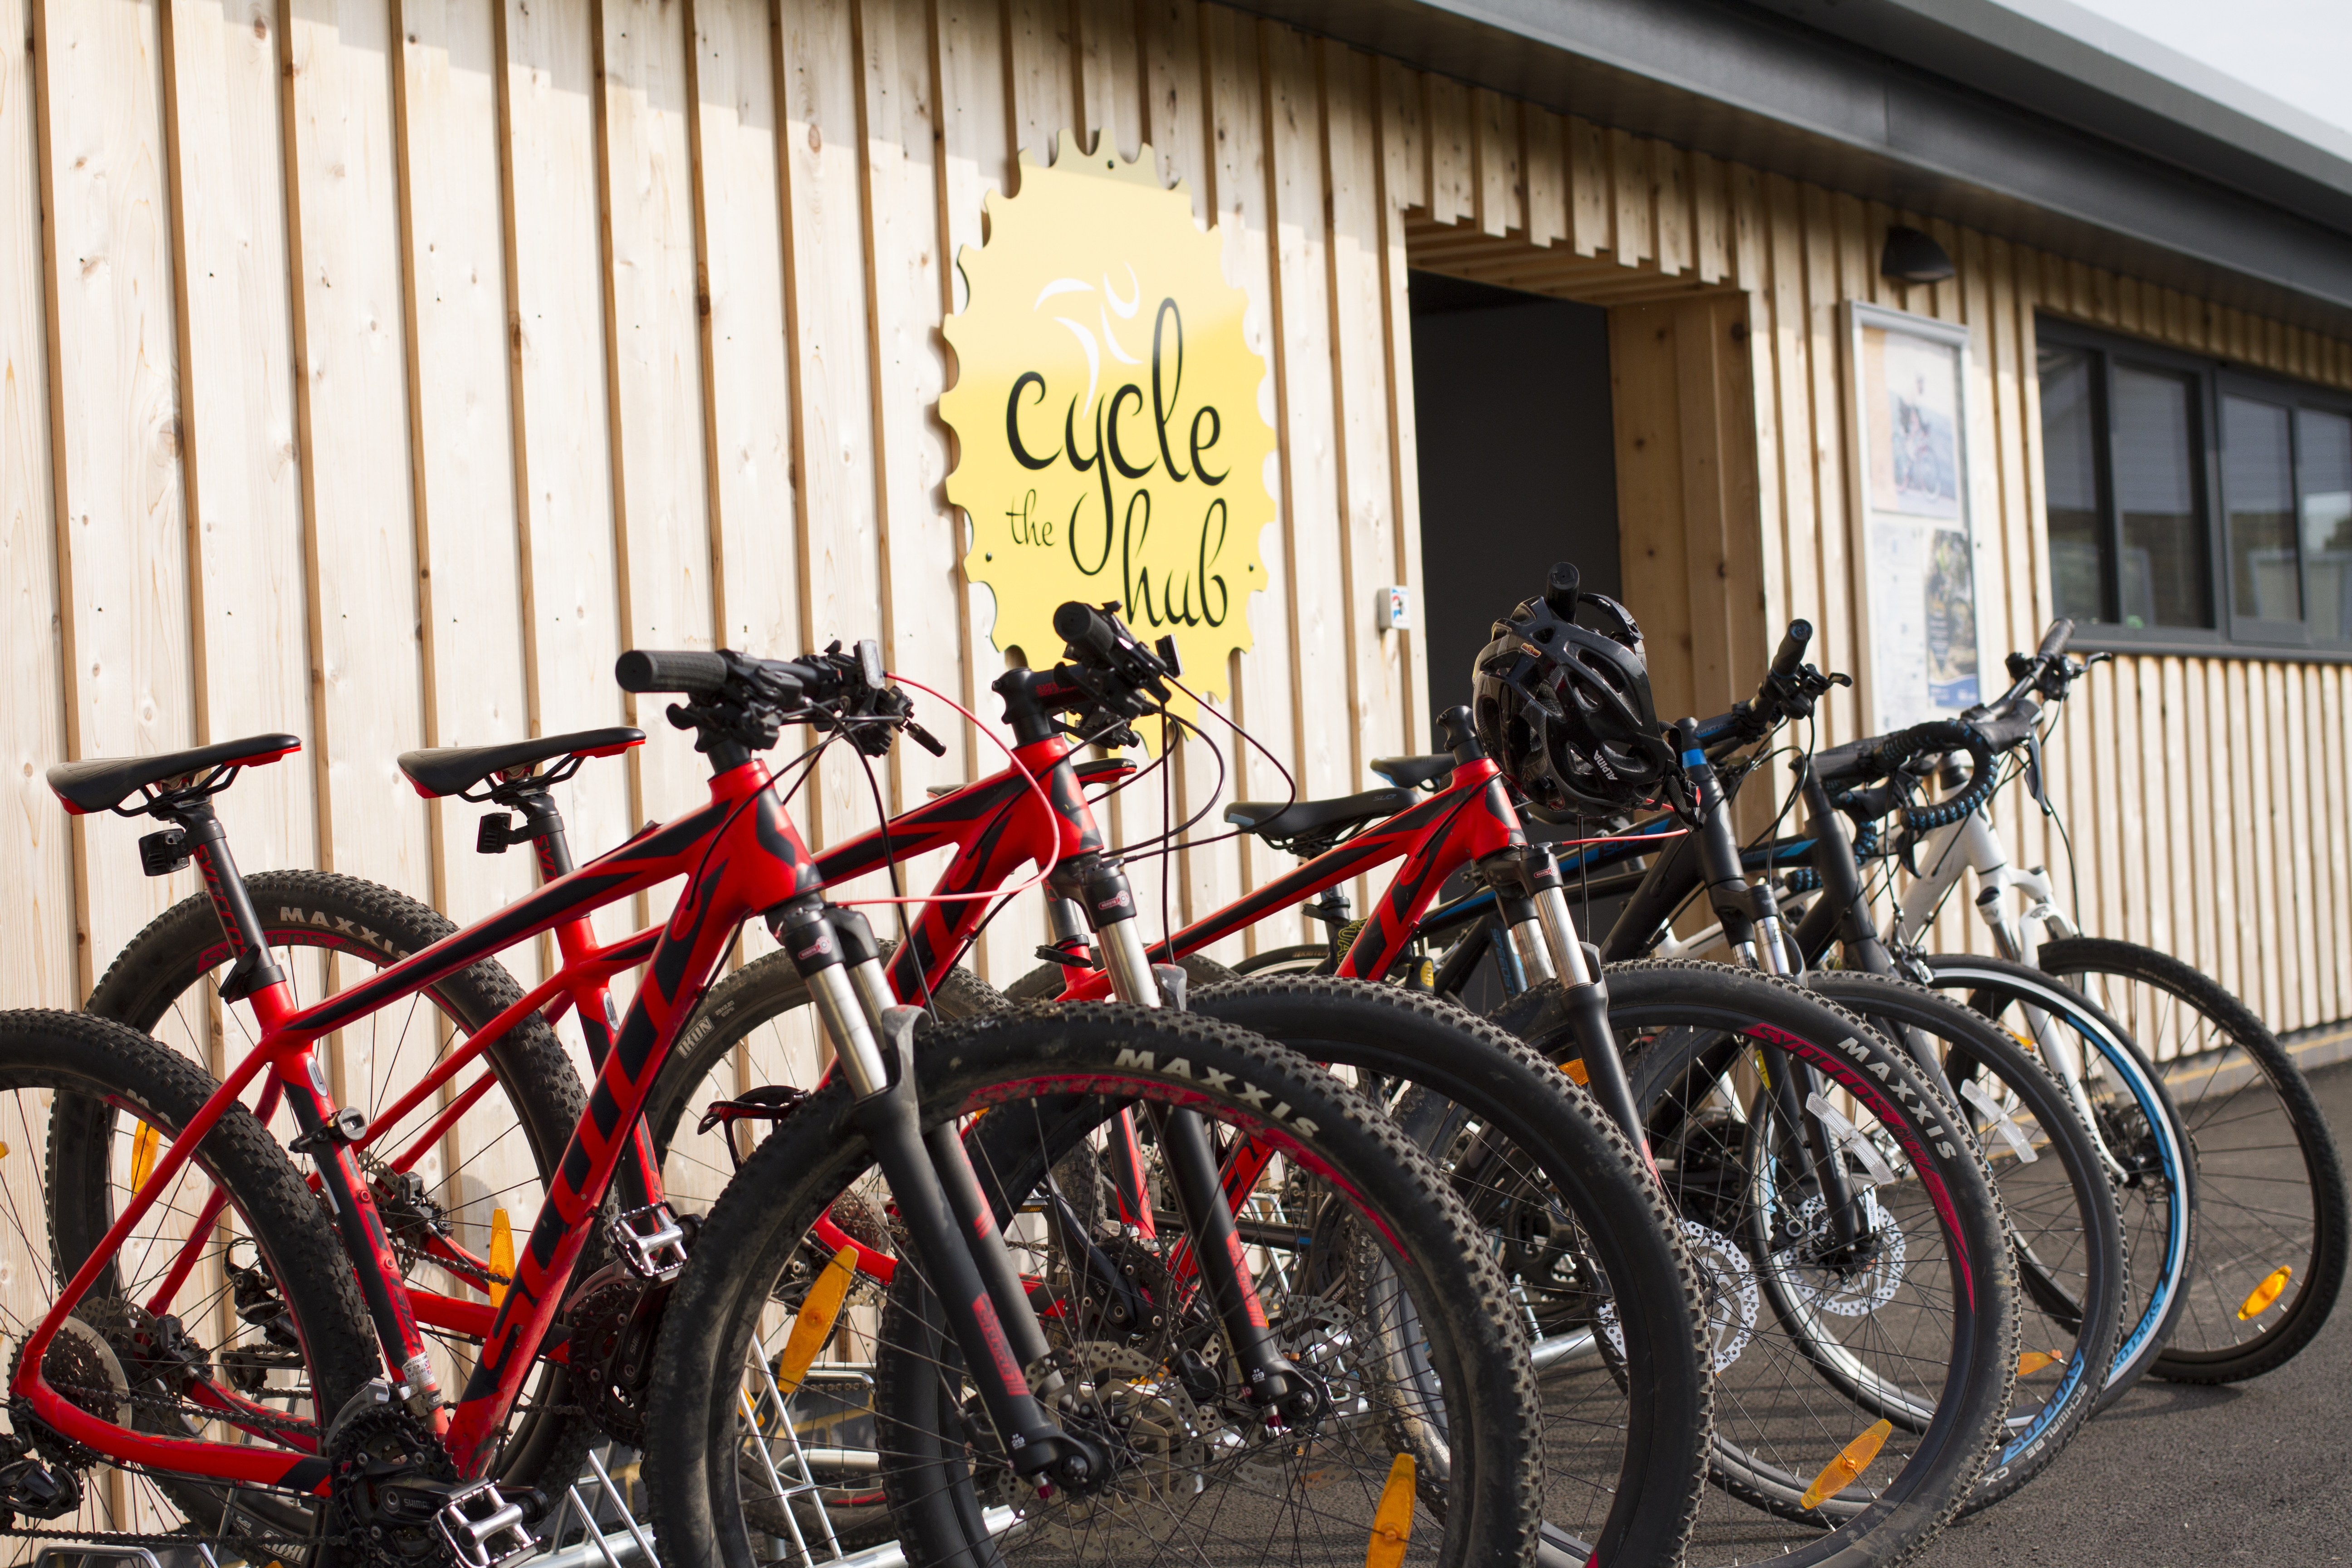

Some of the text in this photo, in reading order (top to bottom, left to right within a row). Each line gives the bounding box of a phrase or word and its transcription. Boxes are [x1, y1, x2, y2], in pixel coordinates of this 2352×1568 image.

[1006, 297, 1231, 576] cycle
[1005, 489, 1056, 546] the
[1123, 489, 1227, 628] hub
[1593, 749, 1618, 780] ALPINA
[197, 844, 247, 956] SYNCRO
[280, 906, 412, 960] MAXXIS
[676, 1015, 715, 1058] IKON
[1114, 1049, 1320, 1138] MAXXIS
[1837, 1036, 1957, 1160] MAXXIS
[2025, 1381, 2087, 1460] SCHWALBE
